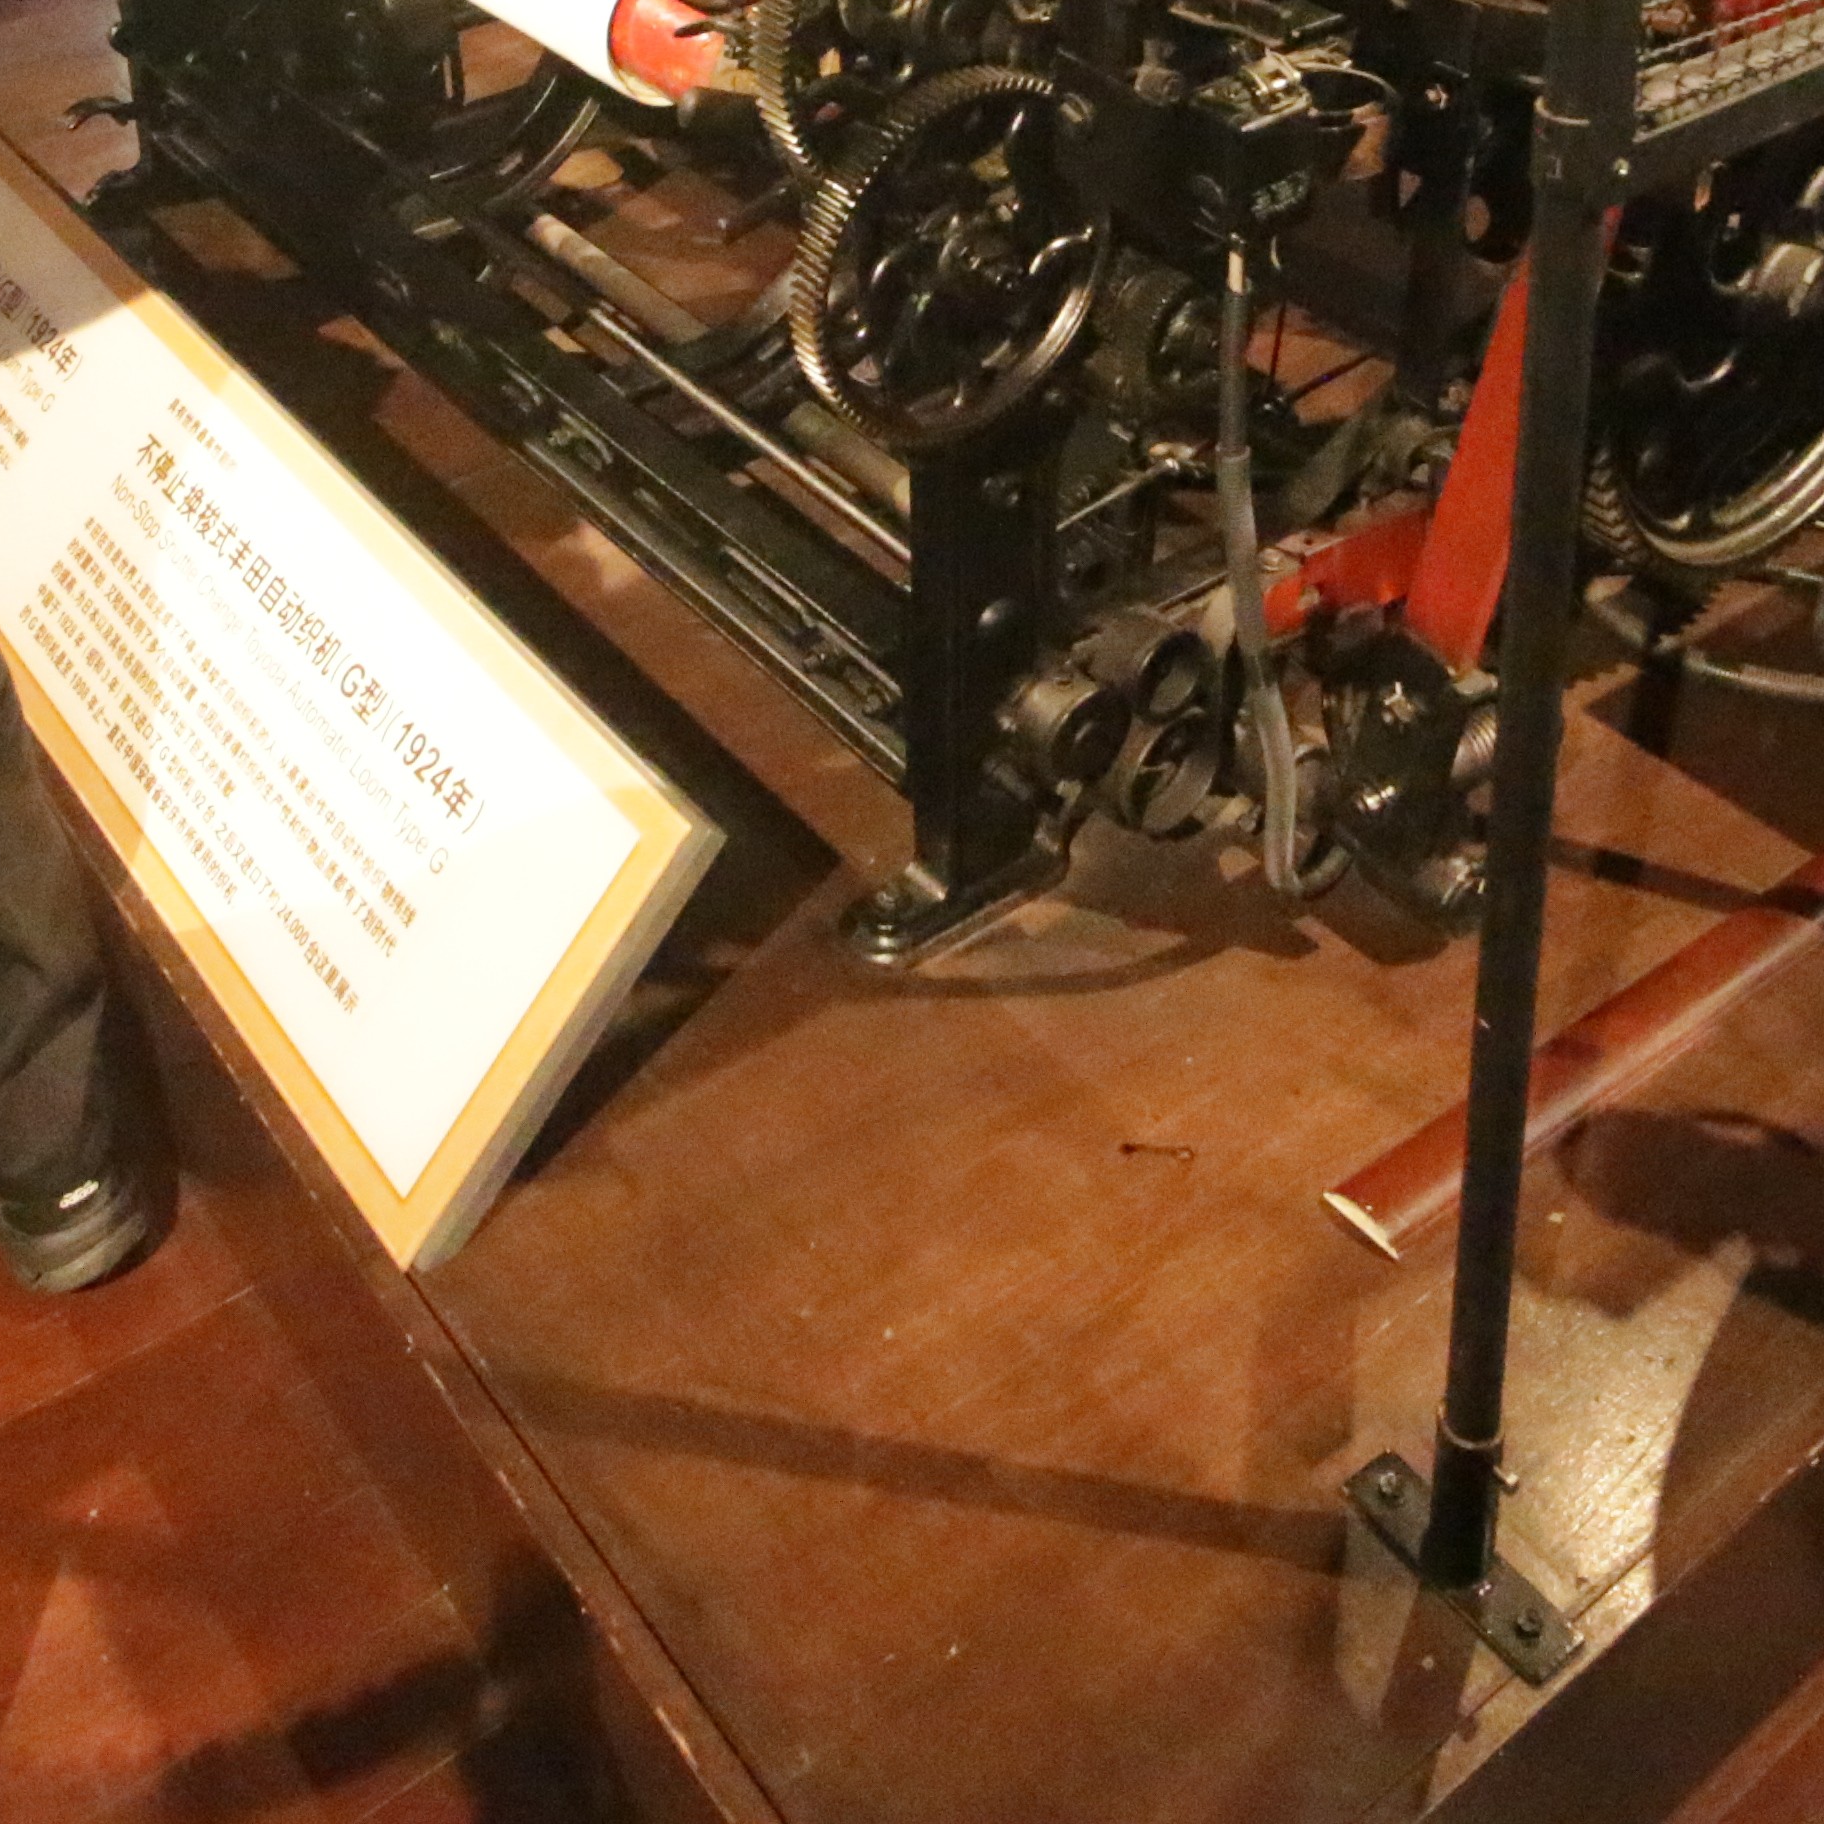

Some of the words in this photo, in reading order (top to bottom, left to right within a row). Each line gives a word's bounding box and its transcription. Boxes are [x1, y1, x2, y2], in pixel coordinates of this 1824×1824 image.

[108, 471, 161, 540] Non-Stop
[196, 574, 243, 634] Change
[243, 624, 287, 688] Toyoda
[285, 680, 352, 763] Automatic
[392, 799, 429, 854] Type
[428, 846, 449, 876] G
